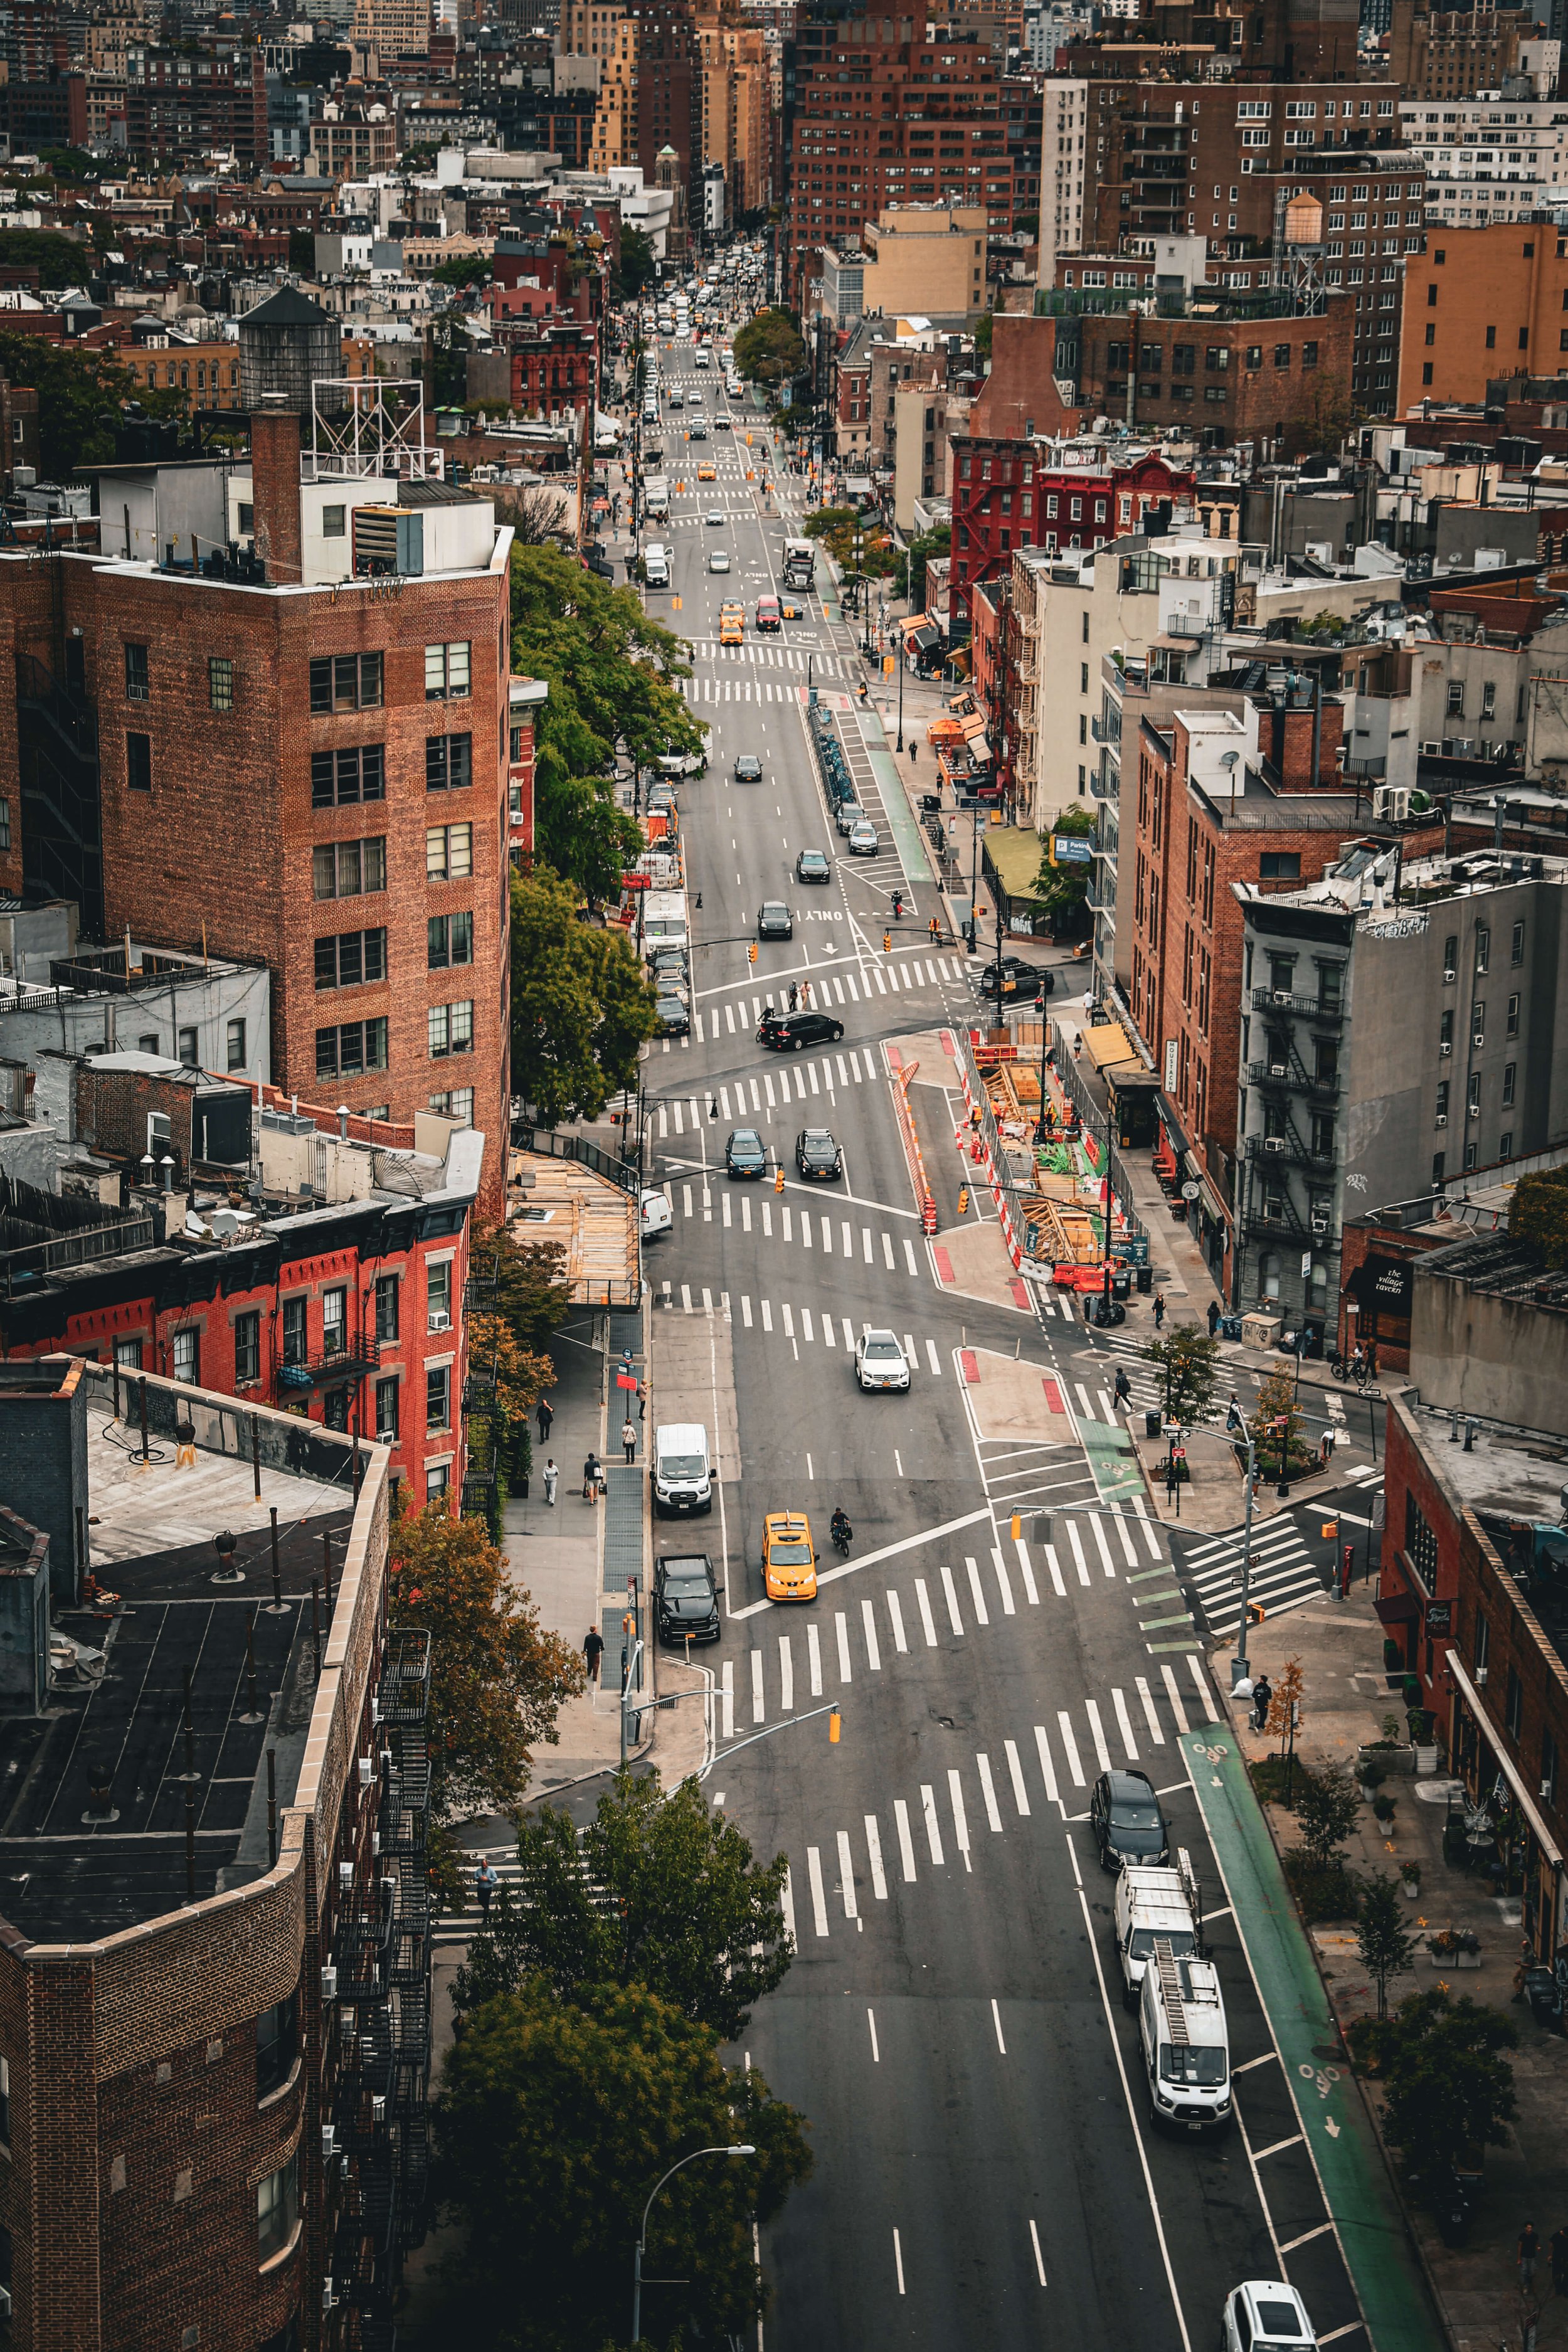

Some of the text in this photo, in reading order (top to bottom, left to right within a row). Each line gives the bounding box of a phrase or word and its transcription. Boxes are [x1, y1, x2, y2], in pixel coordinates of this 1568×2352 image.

[805, 910, 843, 921] ONLY
[1388, 1269, 1401, 1278] the
[1379, 1277, 1404, 1287] village
